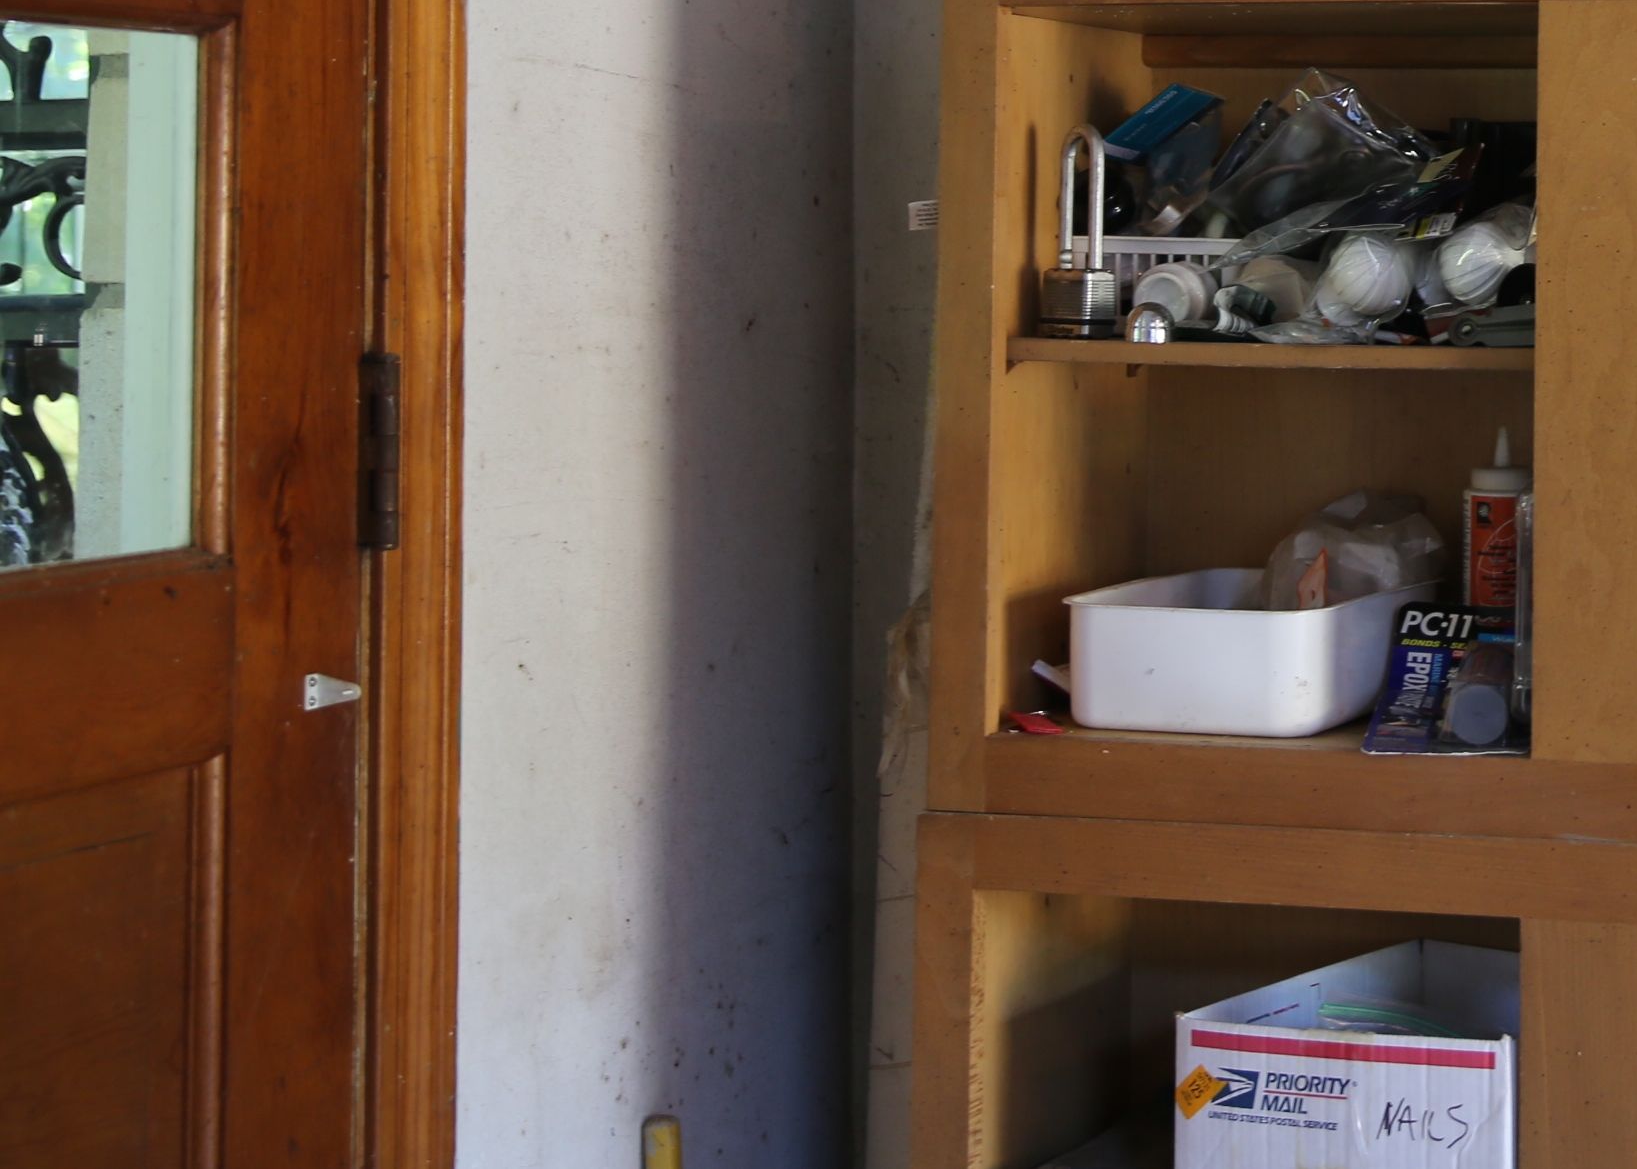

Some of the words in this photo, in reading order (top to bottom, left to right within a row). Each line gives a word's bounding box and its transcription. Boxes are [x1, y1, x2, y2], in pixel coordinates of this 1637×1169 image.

[1401, 637, 1441, 648] BONDS
[1265, 1072, 1351, 1095] PRIORITY
[1260, 1095, 1308, 1114] MAIL
[1208, 1111, 1238, 1122] UNITED
[1239, 1114, 1271, 1125] STATES
[1271, 1117, 1301, 1128] POSTAL
[1302, 1120, 1339, 1131] SERVICE
[1376, 1097, 1469, 1149] NAILS
